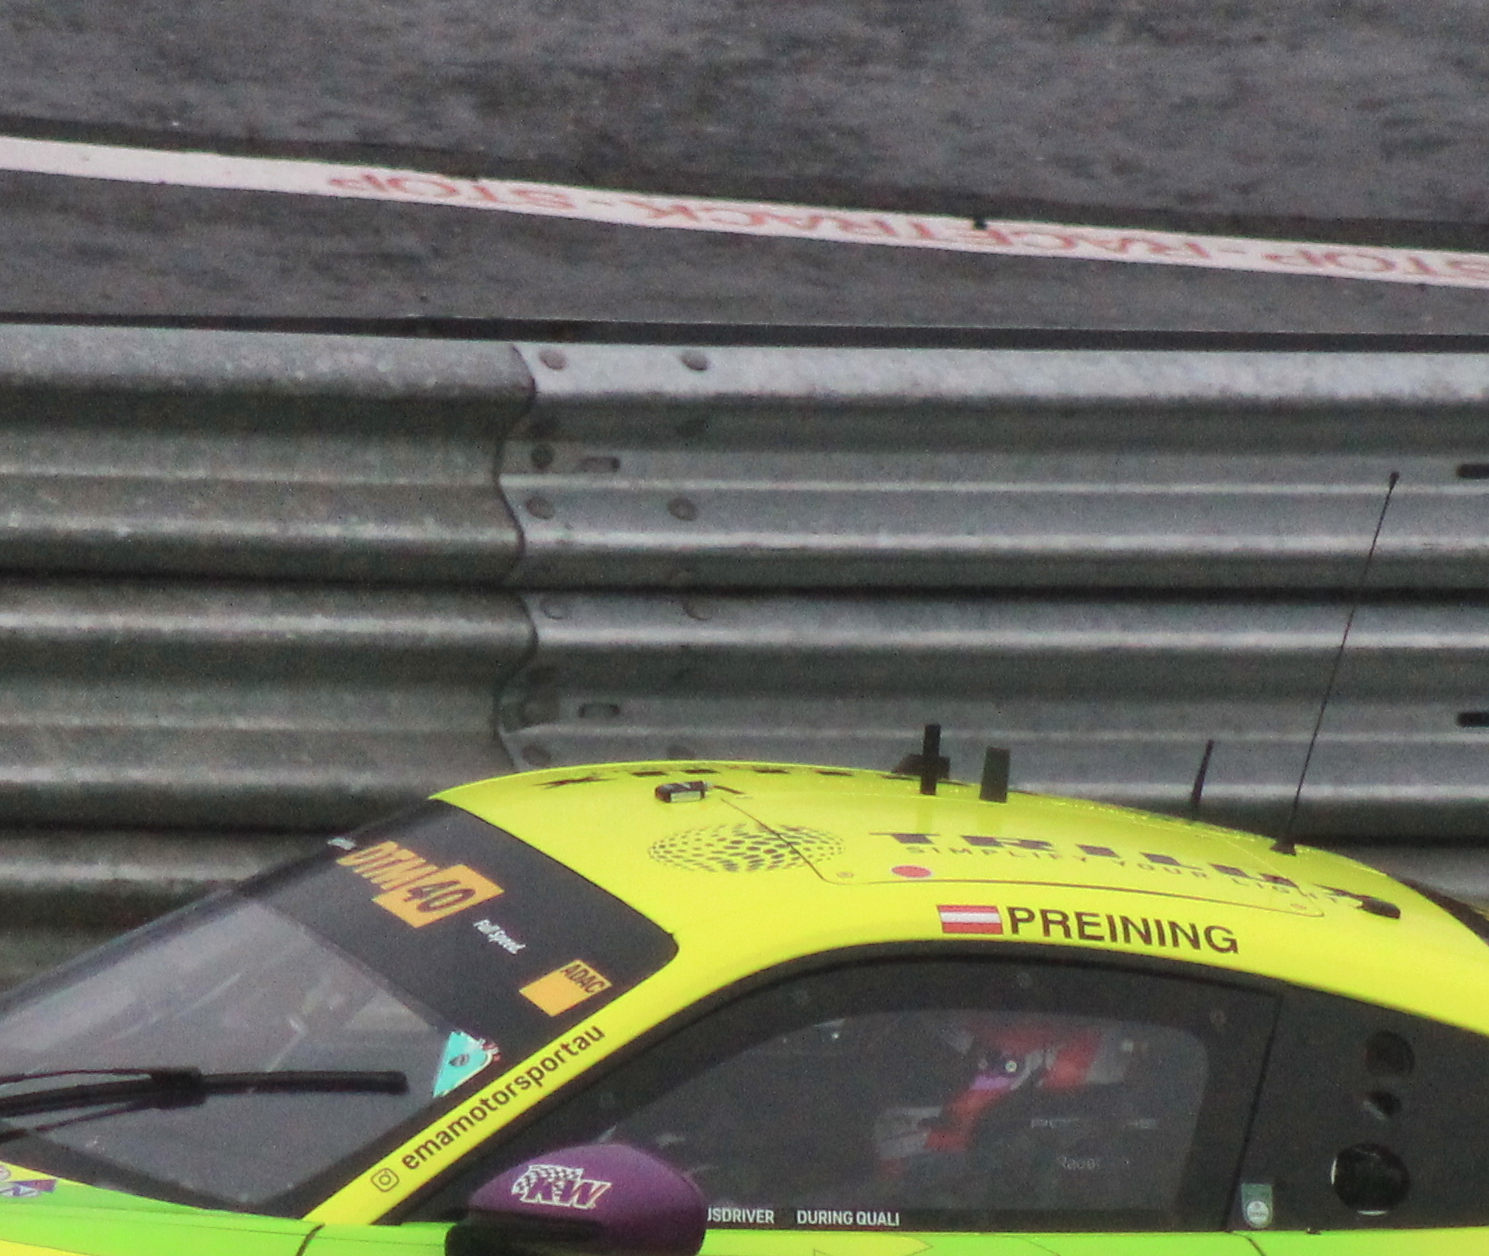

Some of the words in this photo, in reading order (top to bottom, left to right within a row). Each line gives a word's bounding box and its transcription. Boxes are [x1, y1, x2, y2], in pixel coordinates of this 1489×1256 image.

[403, 879, 477, 913] 40
[1006, 905, 1239, 955] PREINING
[561, 963, 606, 994] ADAC
[401, 1024, 607, 1170] emamotorsportau
[515, 1170, 612, 1210] KW
[796, 1209, 854, 1226] DURING
[855, 1211, 901, 1227] QUALI
